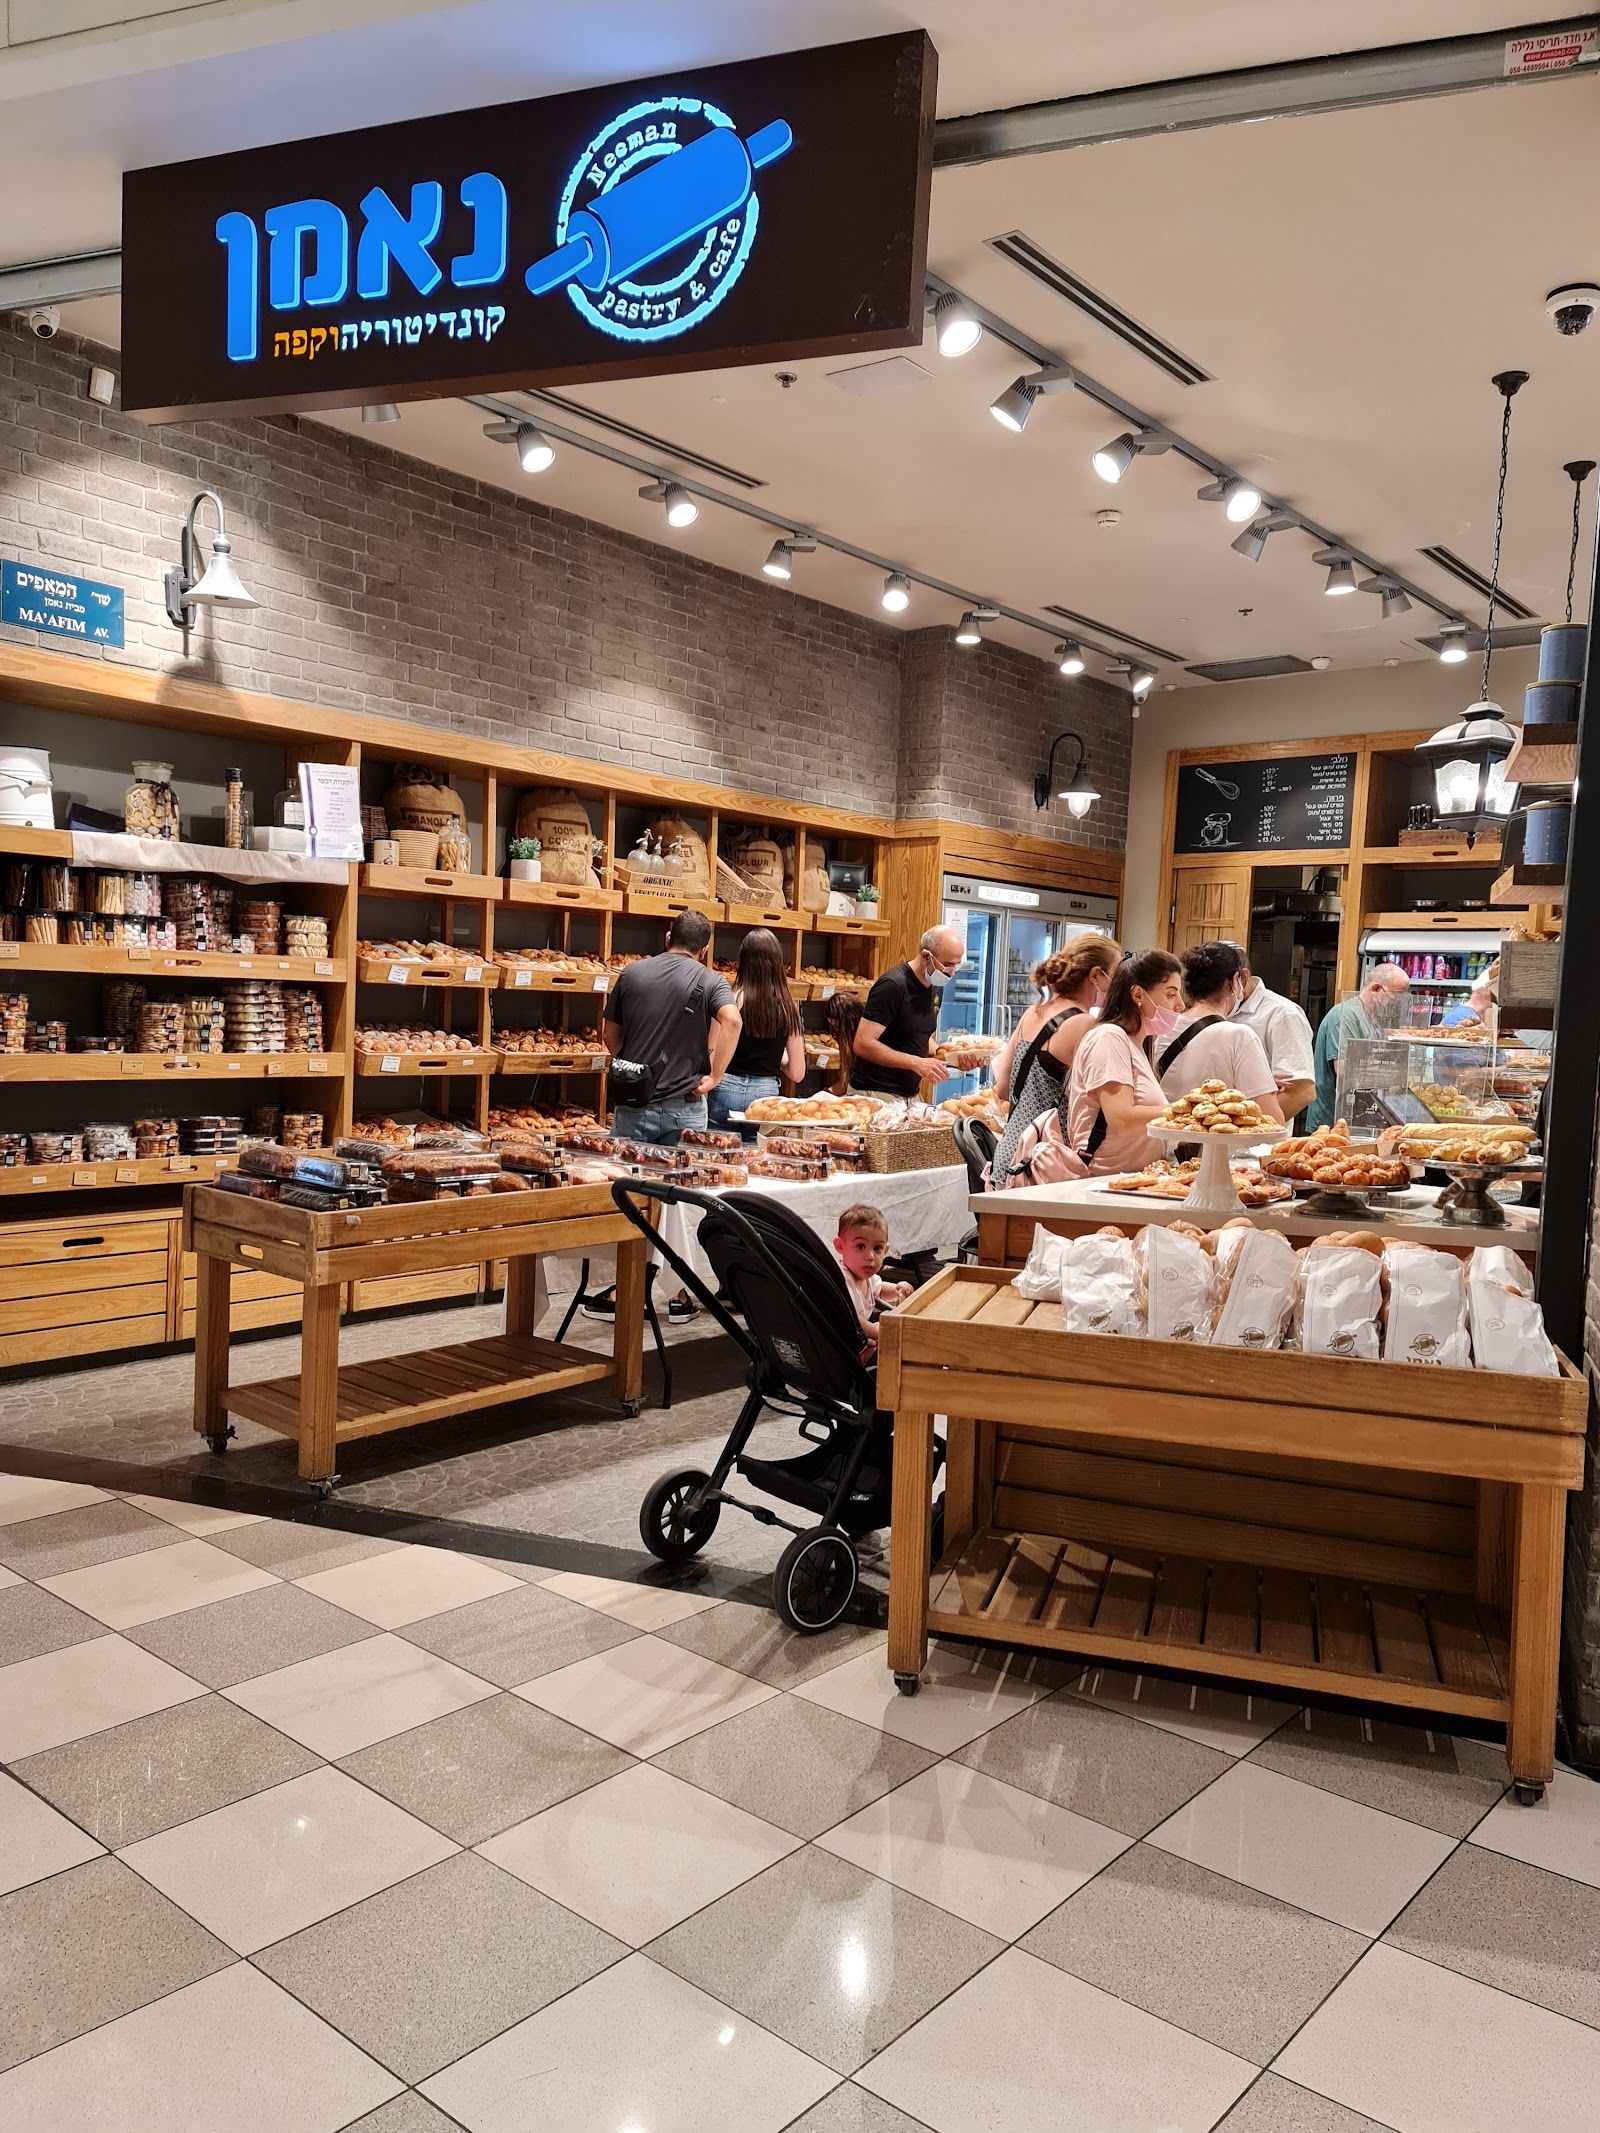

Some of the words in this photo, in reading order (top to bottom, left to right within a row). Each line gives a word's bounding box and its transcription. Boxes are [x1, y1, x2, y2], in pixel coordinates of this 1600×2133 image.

[586, 121, 677, 188] Neeman
[215, 172, 508, 362] נאמן
[598, 290, 681, 321] pastry
[689, 280, 706, 300] &
[709, 218, 741, 278] cafe
[44, 597, 64, 609] נאמן
[65, 602, 86, 614] מבית
[19, 607, 86, 634] MA'AFIM
[94, 626, 110, 639] AV.
[552, 826, 576, 836] 100%
[643, 876, 675, 887] ORGANIC
